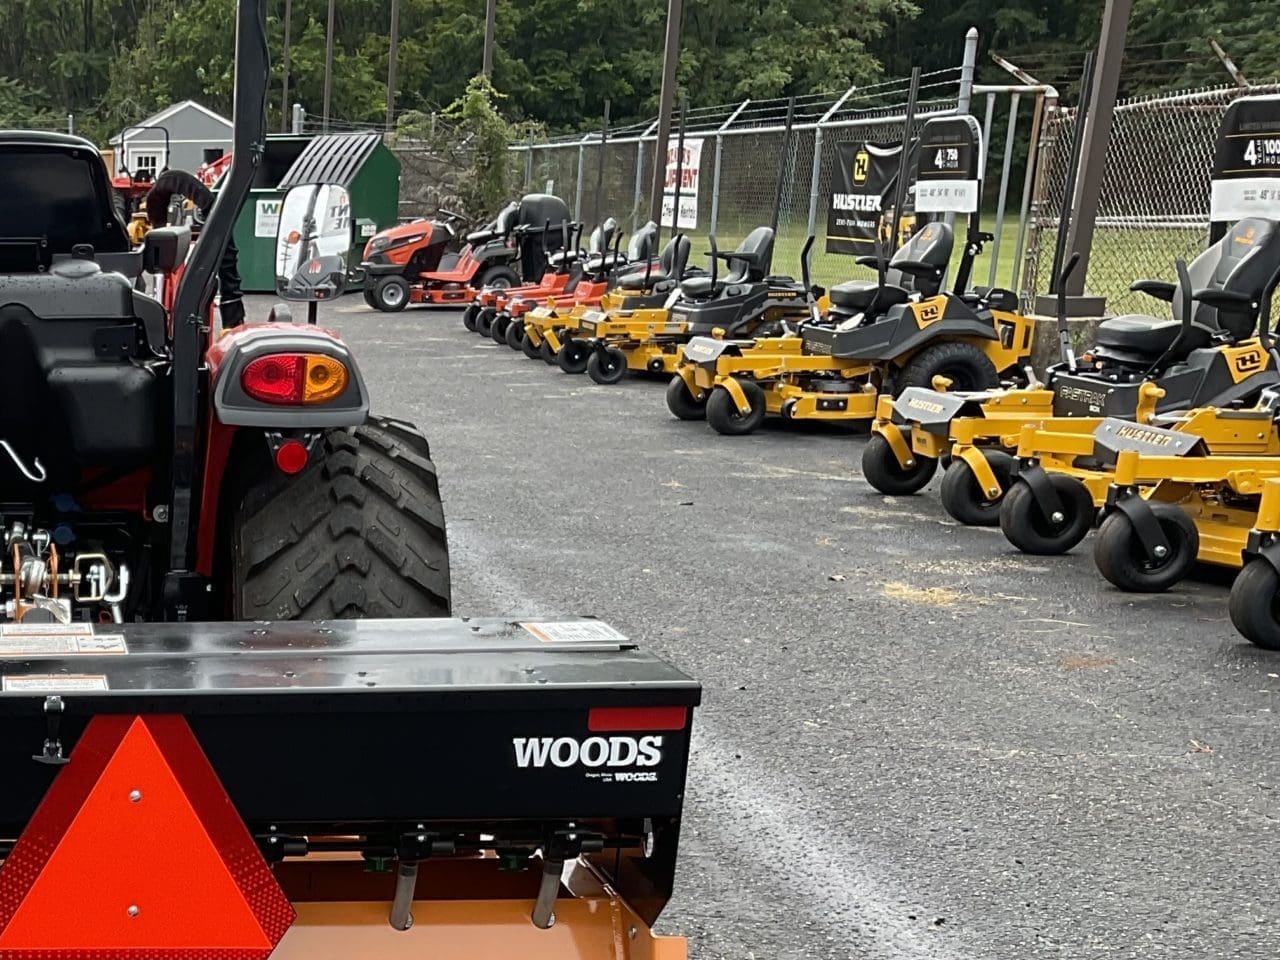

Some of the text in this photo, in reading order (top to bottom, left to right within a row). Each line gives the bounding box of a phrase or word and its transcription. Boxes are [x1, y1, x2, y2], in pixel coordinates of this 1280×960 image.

[1244, 139, 1257, 166] 4
[833, 193, 882, 212] HUSTLER
[1060, 385, 1106, 407] FASTRAK
[1116, 425, 1173, 447] HUSTLER
[512, 735, 663, 768] WOODS
